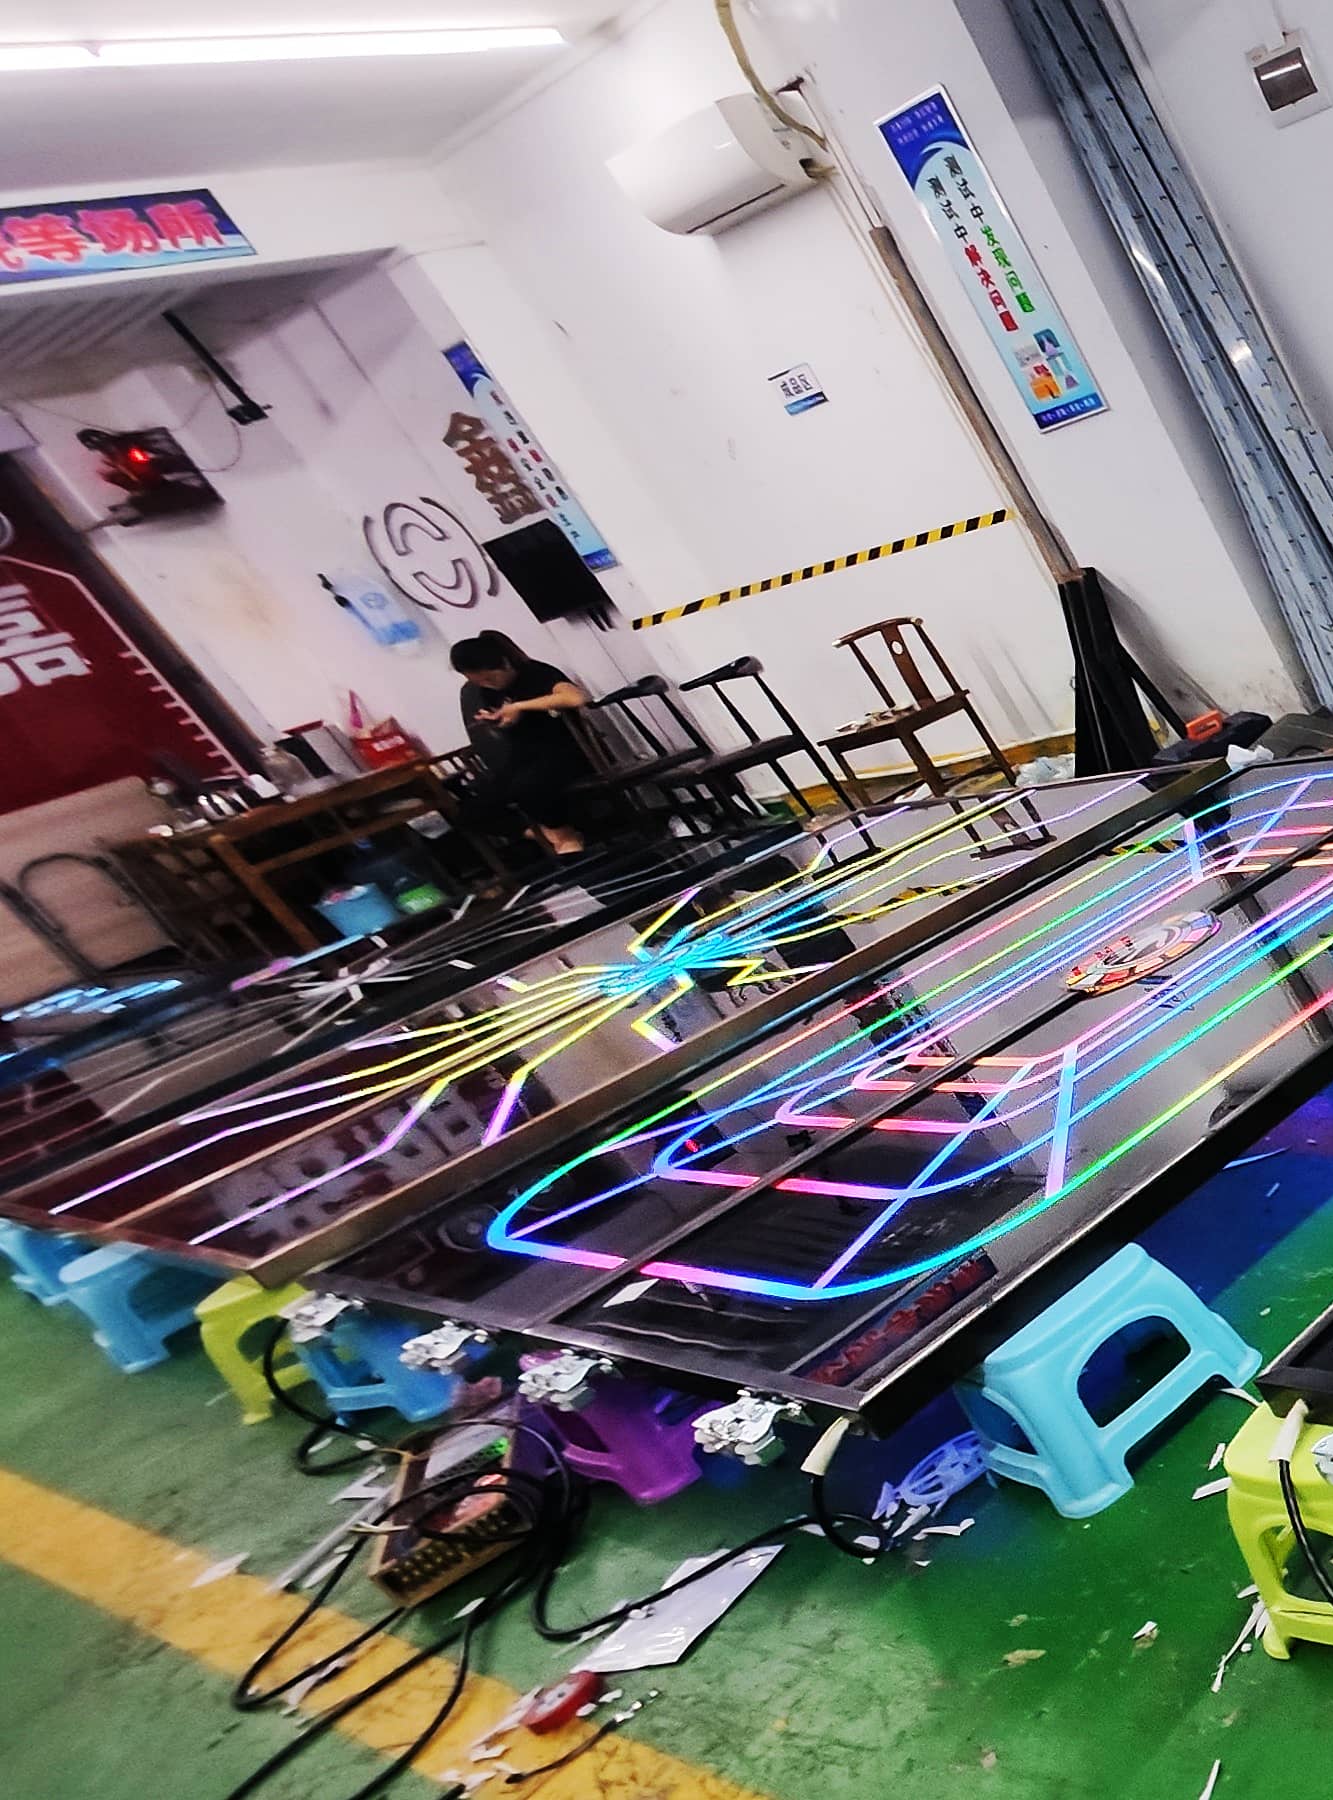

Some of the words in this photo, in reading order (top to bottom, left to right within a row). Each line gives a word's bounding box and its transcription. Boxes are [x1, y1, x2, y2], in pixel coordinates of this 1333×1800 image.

[0, 200, 226, 271] 等场所
[926, 174, 1019, 332] 测试中解决问题
[943, 153, 1036, 314] 测试中发现问题
